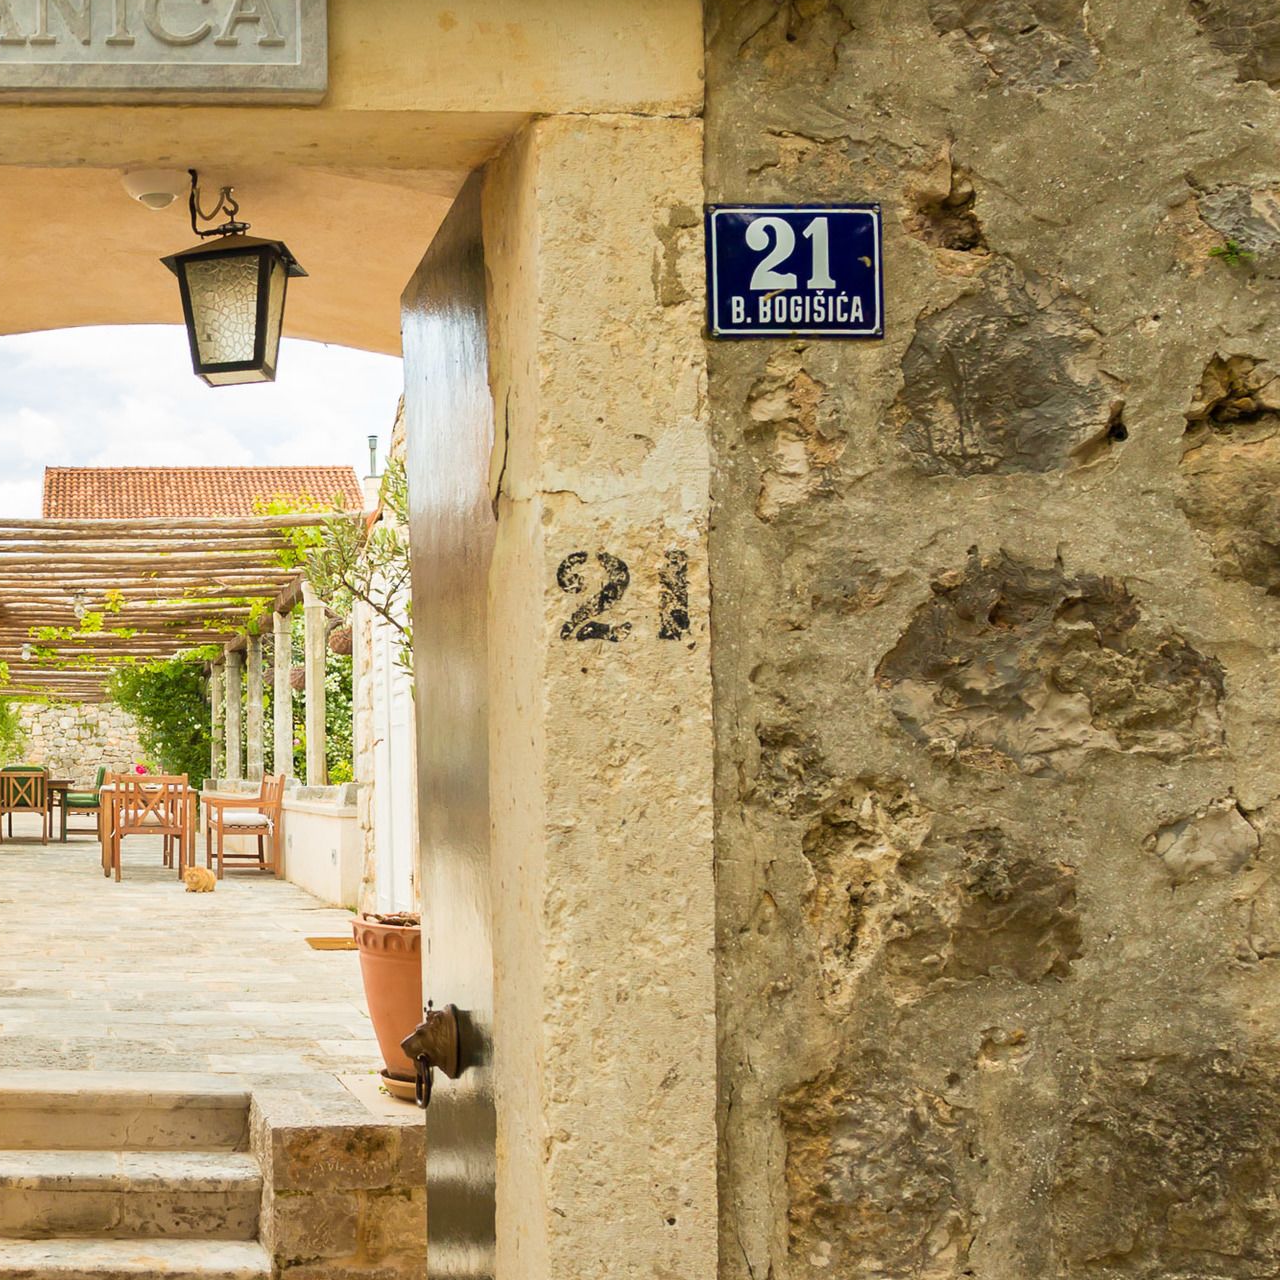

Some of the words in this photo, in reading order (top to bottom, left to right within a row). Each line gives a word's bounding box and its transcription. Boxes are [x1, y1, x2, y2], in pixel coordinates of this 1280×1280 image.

[745, 216, 837, 290] 21
[731, 296, 752, 324] B.
[758, 290, 864, 324] BOGIŠIĆA
[556, 550, 690, 642] 21
